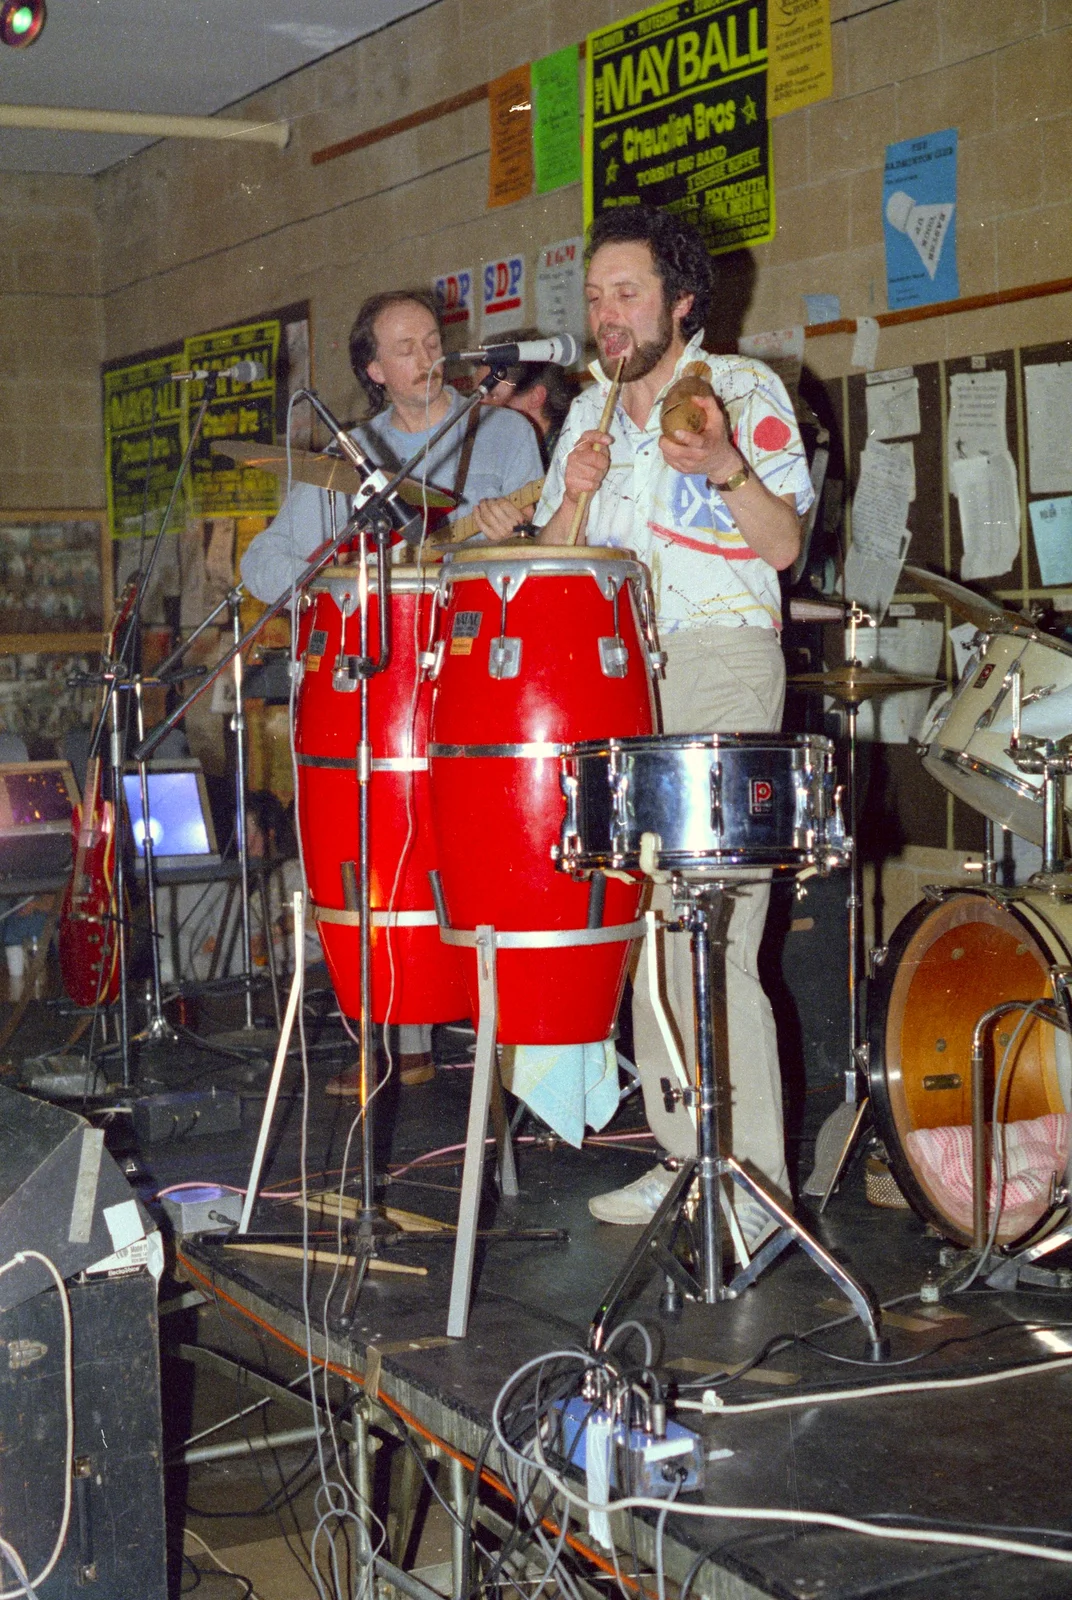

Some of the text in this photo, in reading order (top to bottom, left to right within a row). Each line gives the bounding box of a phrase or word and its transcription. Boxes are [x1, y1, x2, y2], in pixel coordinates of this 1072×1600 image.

[693, 99, 736, 141] Bros
[435, 272, 470, 310] SDP
[484, 258, 522, 302] SDP
